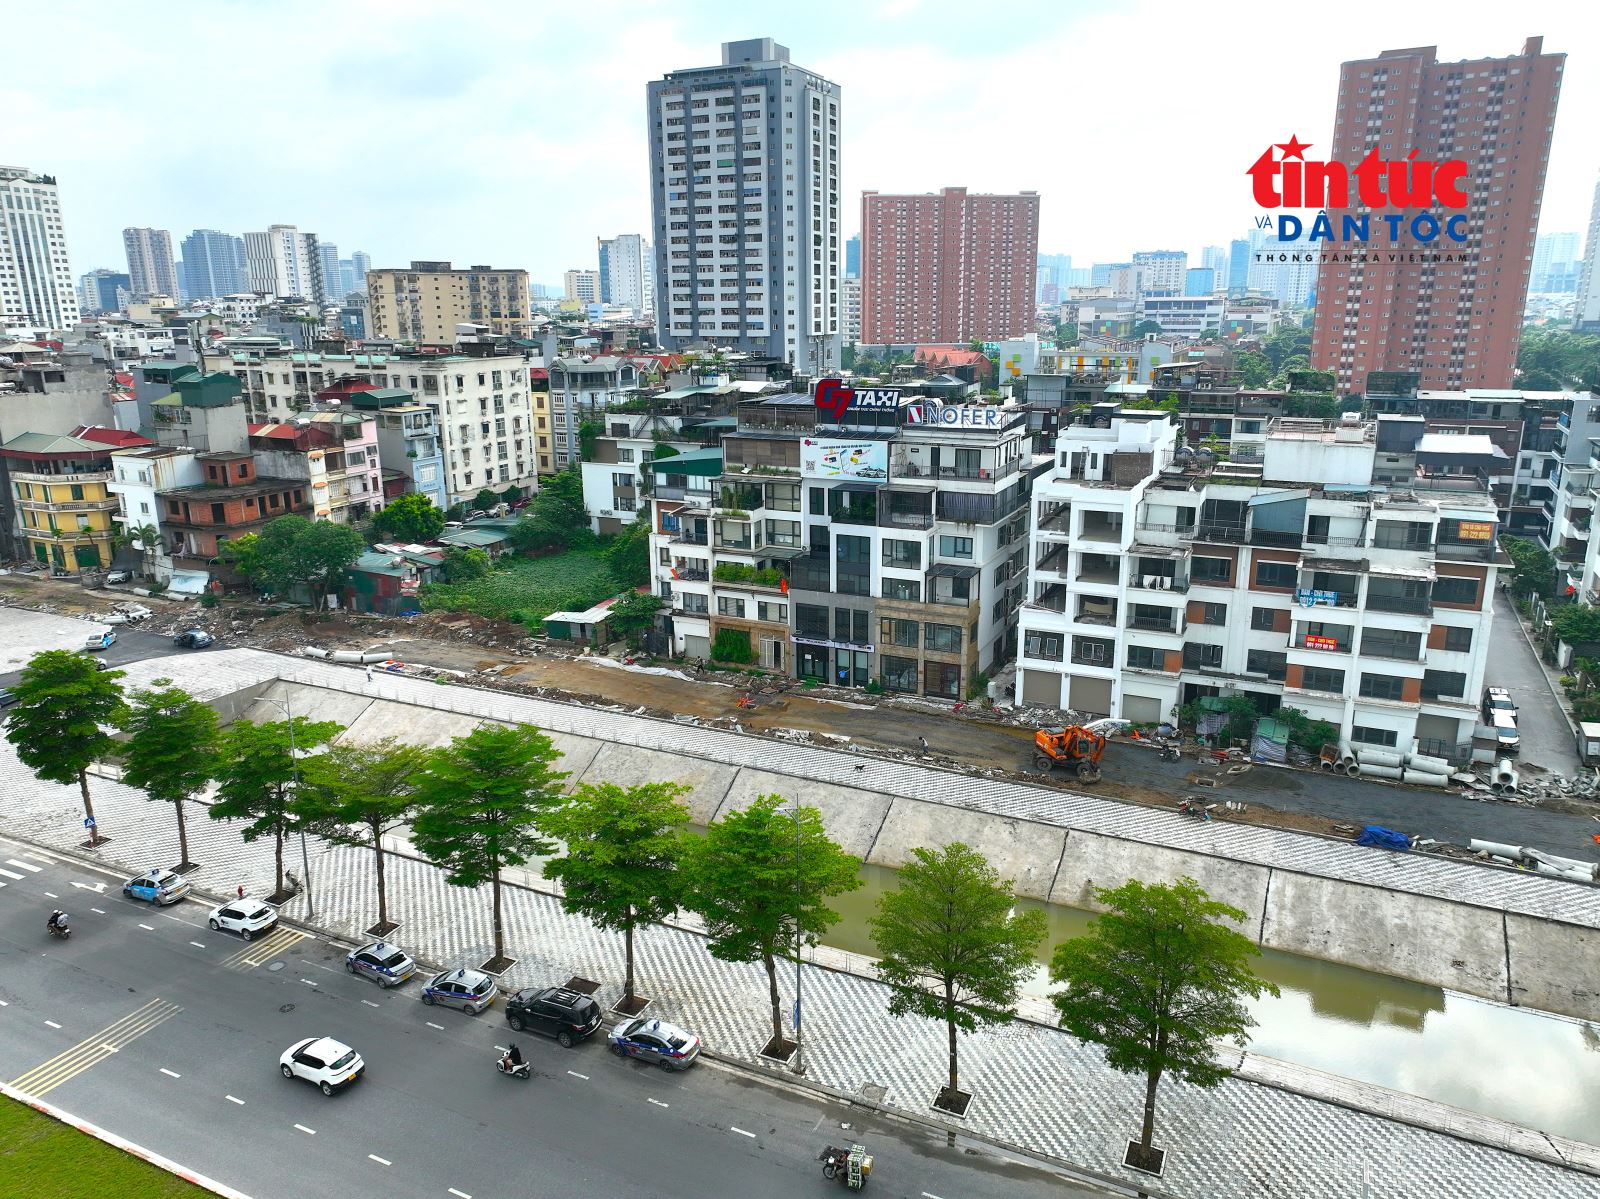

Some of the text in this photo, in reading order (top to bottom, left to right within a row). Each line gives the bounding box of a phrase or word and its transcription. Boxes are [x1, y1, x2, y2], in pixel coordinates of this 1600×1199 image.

[815, 378, 898, 420] G7 TAXI
[927, 407, 996, 426] NOFER
